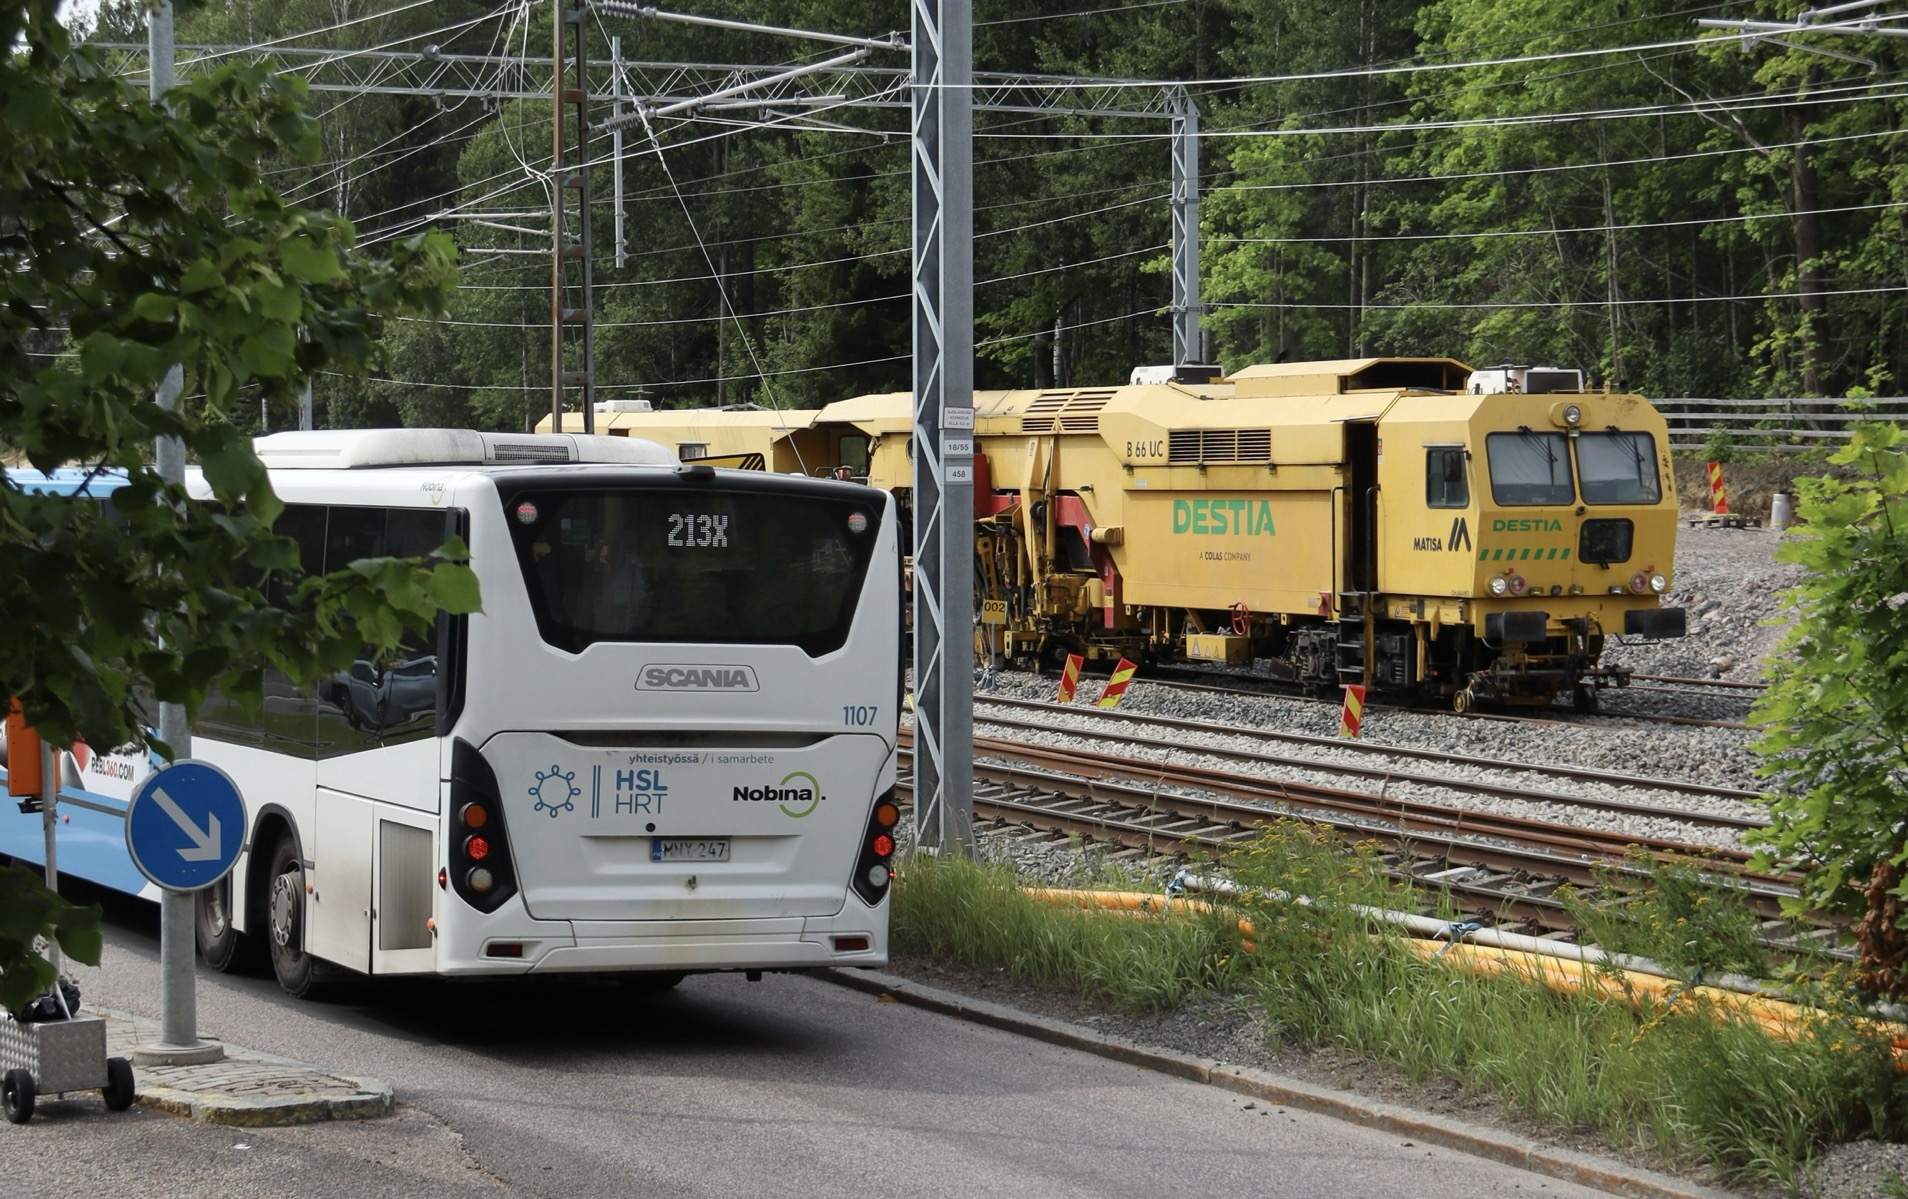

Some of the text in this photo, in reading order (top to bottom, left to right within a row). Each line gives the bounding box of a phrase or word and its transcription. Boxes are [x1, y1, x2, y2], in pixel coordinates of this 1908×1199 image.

[948, 443, 969, 451] 18/55
[1126, 440, 1164, 458] B 66 UC
[952, 470, 966, 478] 458
[1173, 499, 1276, 537] DESTIA
[1493, 518, 1562, 532] DESTIA
[667, 513, 728, 548] 213X
[1413, 537, 1442, 552] MATISA
[1204, 551, 1222, 561] COLAS
[1223, 551, 1251, 561] COMPANY
[984, 601, 1006, 613] 002
[645, 668, 750, 688] SCANIA
[843, 706, 878, 726] 1107
[628, 753, 699, 765] yhteistyössä
[717, 753, 775, 764] samarbete
[91, 756, 134, 782] REBL360.COM
[616, 769, 668, 792] HSL
[616, 793, 668, 815] HRT
